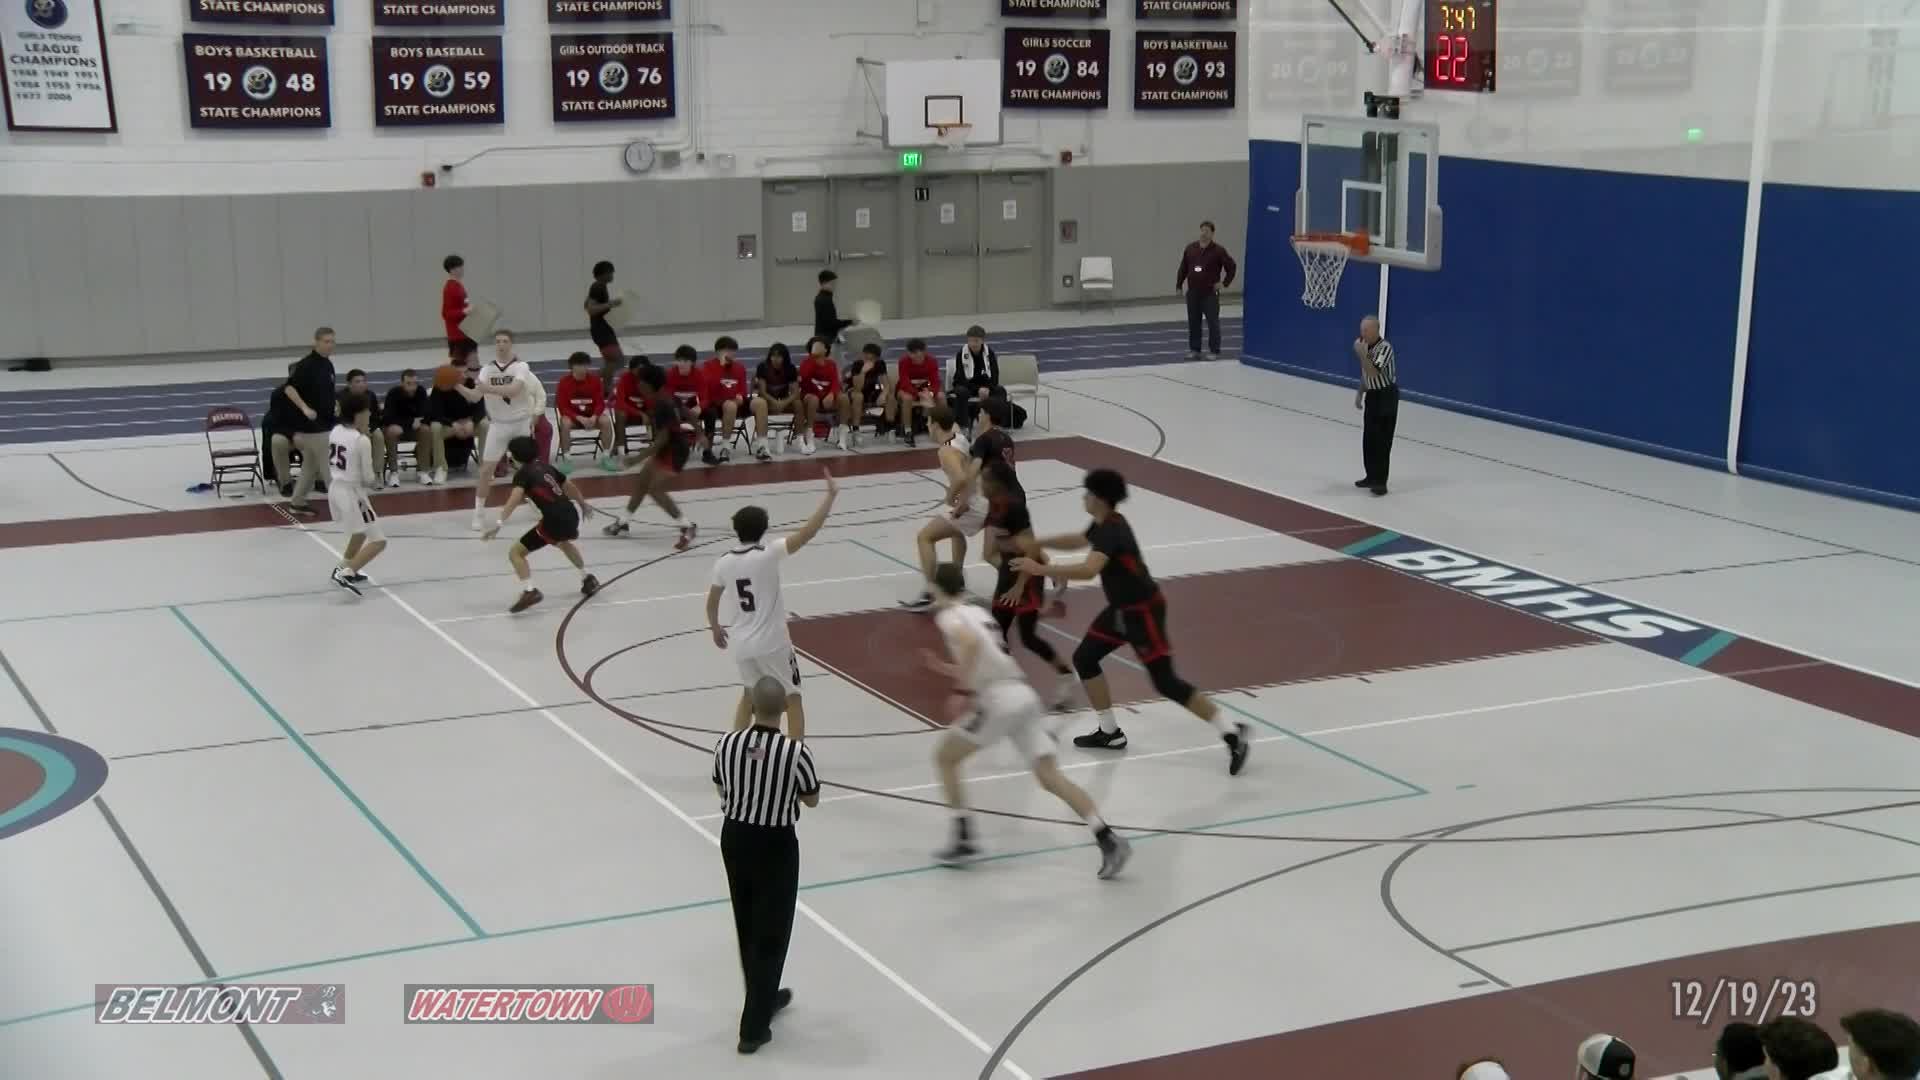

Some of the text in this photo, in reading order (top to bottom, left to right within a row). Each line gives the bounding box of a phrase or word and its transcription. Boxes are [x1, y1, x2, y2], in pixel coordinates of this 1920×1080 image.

[201, 1, 325, 14] STATE CHAMPIONS
[383, 5, 496, 14] STATE CHAMPIONS
[556, 0, 662, 12] STATE CHAMPIONS
[1040, 0, 1100, 8] CHAMPIONS
[1143, 1, 1231, 10] STATE CHAMPIONS
[1441, 5, 1476, 30] 7:47
[24, 43, 80, 54] LEAGUE
[1022, 37, 1092, 48] GIRLS SOCCER
[1143, 40, 1229, 50] BOYS BASKETBALL
[194, 45, 318, 59] BOYS BASKETBALL
[390, 47, 486, 58] BOYS BASEBALL
[560, 43, 665, 56] GIRLS OUTDOOR TRACK
[10, 55, 97, 68] CHAMPIONS
[1436, 35, 1468, 81] 22
[1016, 60, 1100, 77] 19 84
[1146, 61, 1225, 79] 19 93
[203, 72, 316, 92] 19 48
[388, 71, 491, 90] 19 59
[566, 67, 662, 87] 19 76
[1010, 89, 1102, 100] STATE CHAMPIONS
[1141, 90, 1229, 100] STATE CHAMPIONS
[384, 103, 496, 116] STATE CHAMPIONS
[561, 98, 668, 112] STATE CHAMPIONS
[200, 107, 322, 118] STATE CHAMPIONS
[903, 153, 921, 167] EXIT
[329, 443, 347, 471] 25
[735, 577, 756, 612] 5
[1364, 548, 1702, 639] BMHS
